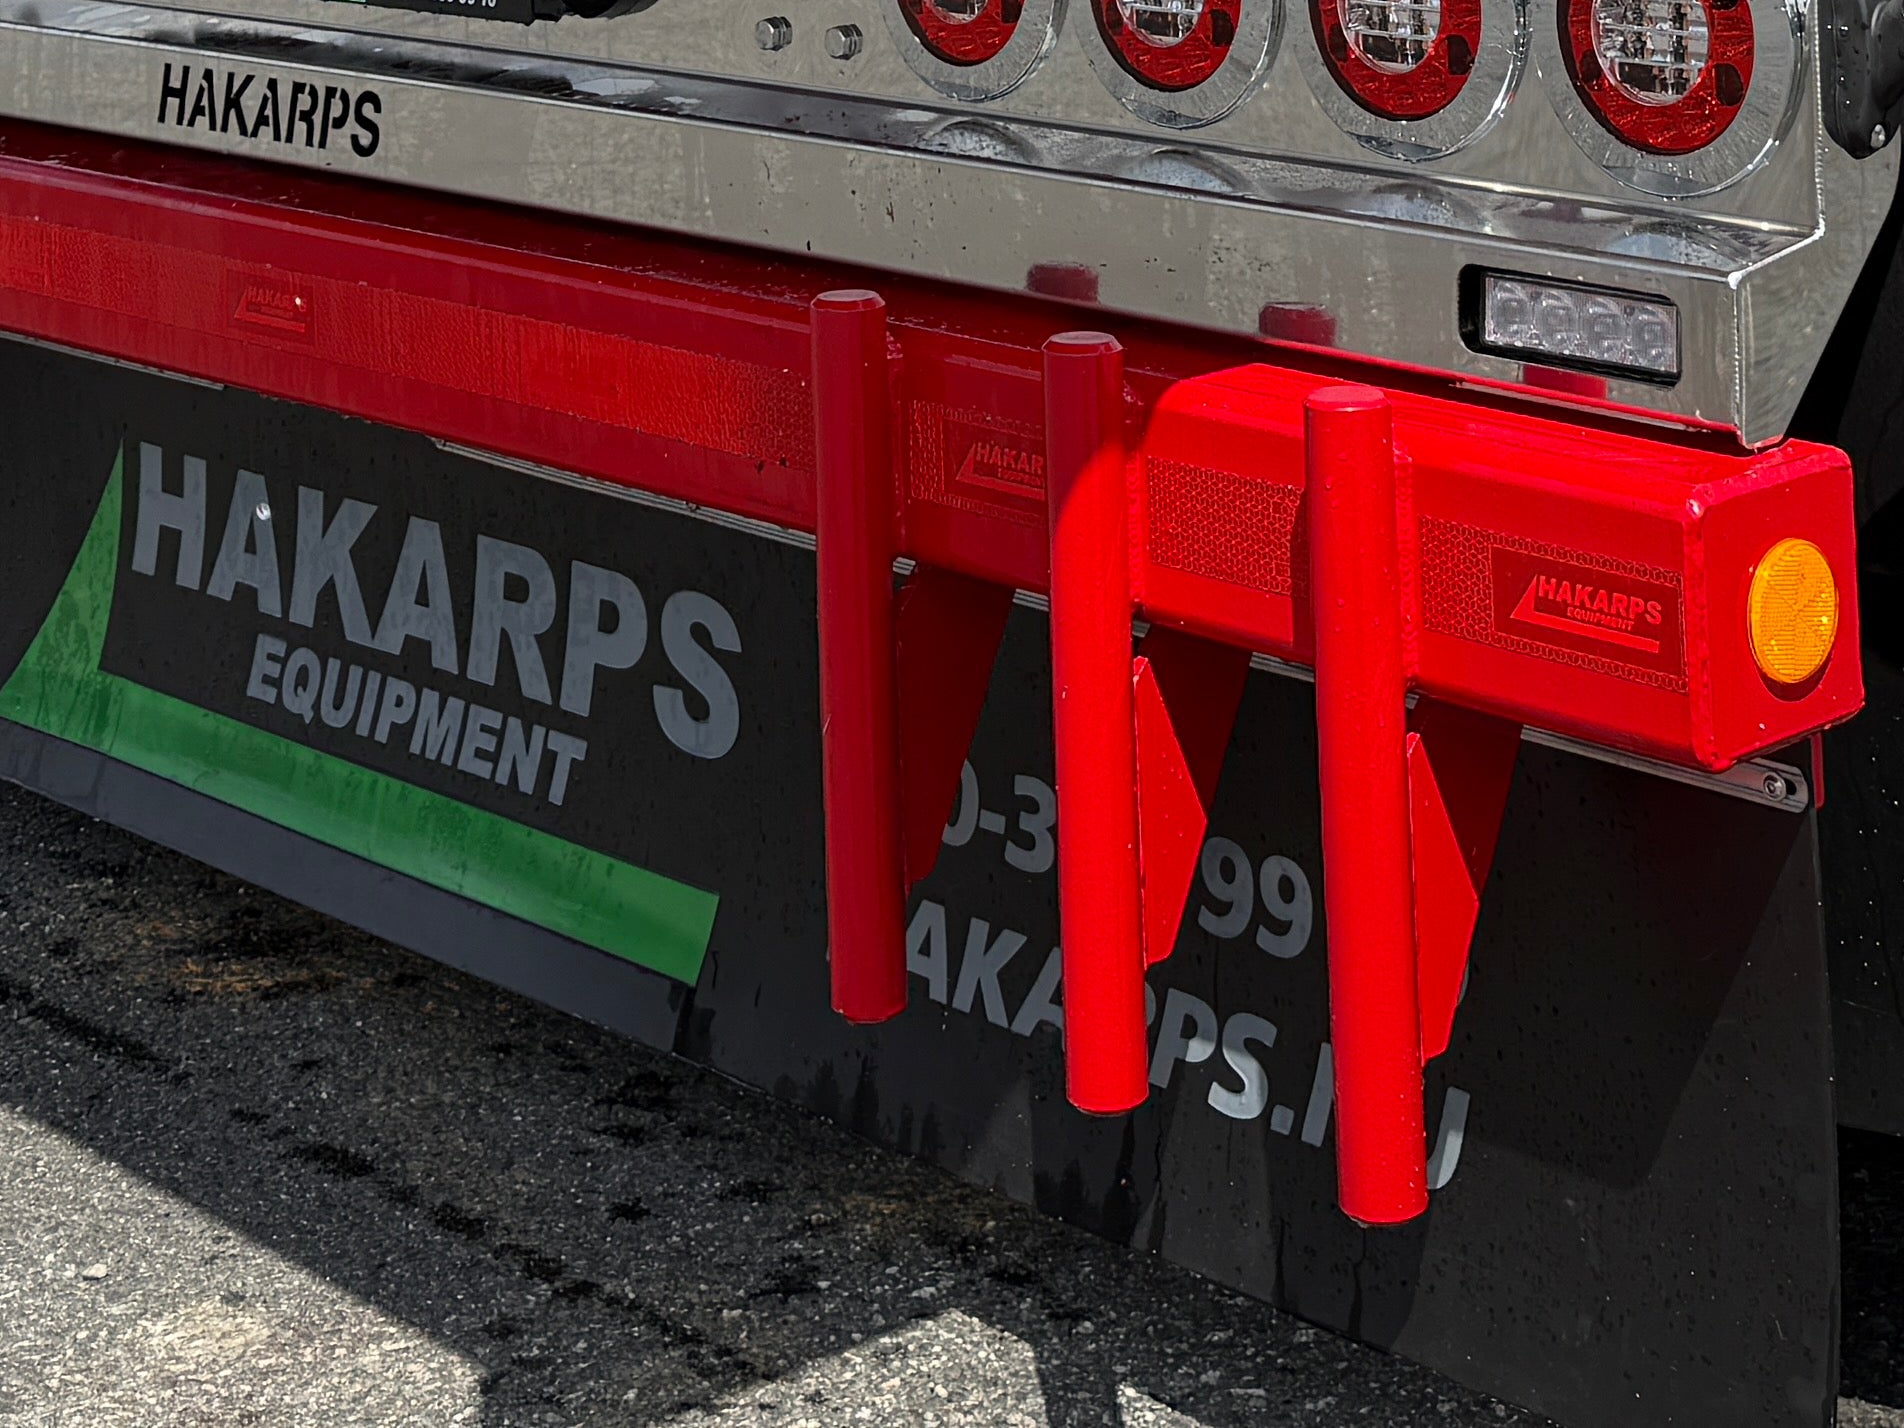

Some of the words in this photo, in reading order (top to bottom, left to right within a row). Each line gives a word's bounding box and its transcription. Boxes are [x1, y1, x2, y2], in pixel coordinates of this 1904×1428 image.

[157, 62, 383, 158] HAKARPS
[131, 441, 742, 760] HAKARPS
[1538, 575, 1662, 625] HAKARPS
[247, 633, 589, 807] EQUIPMENT
